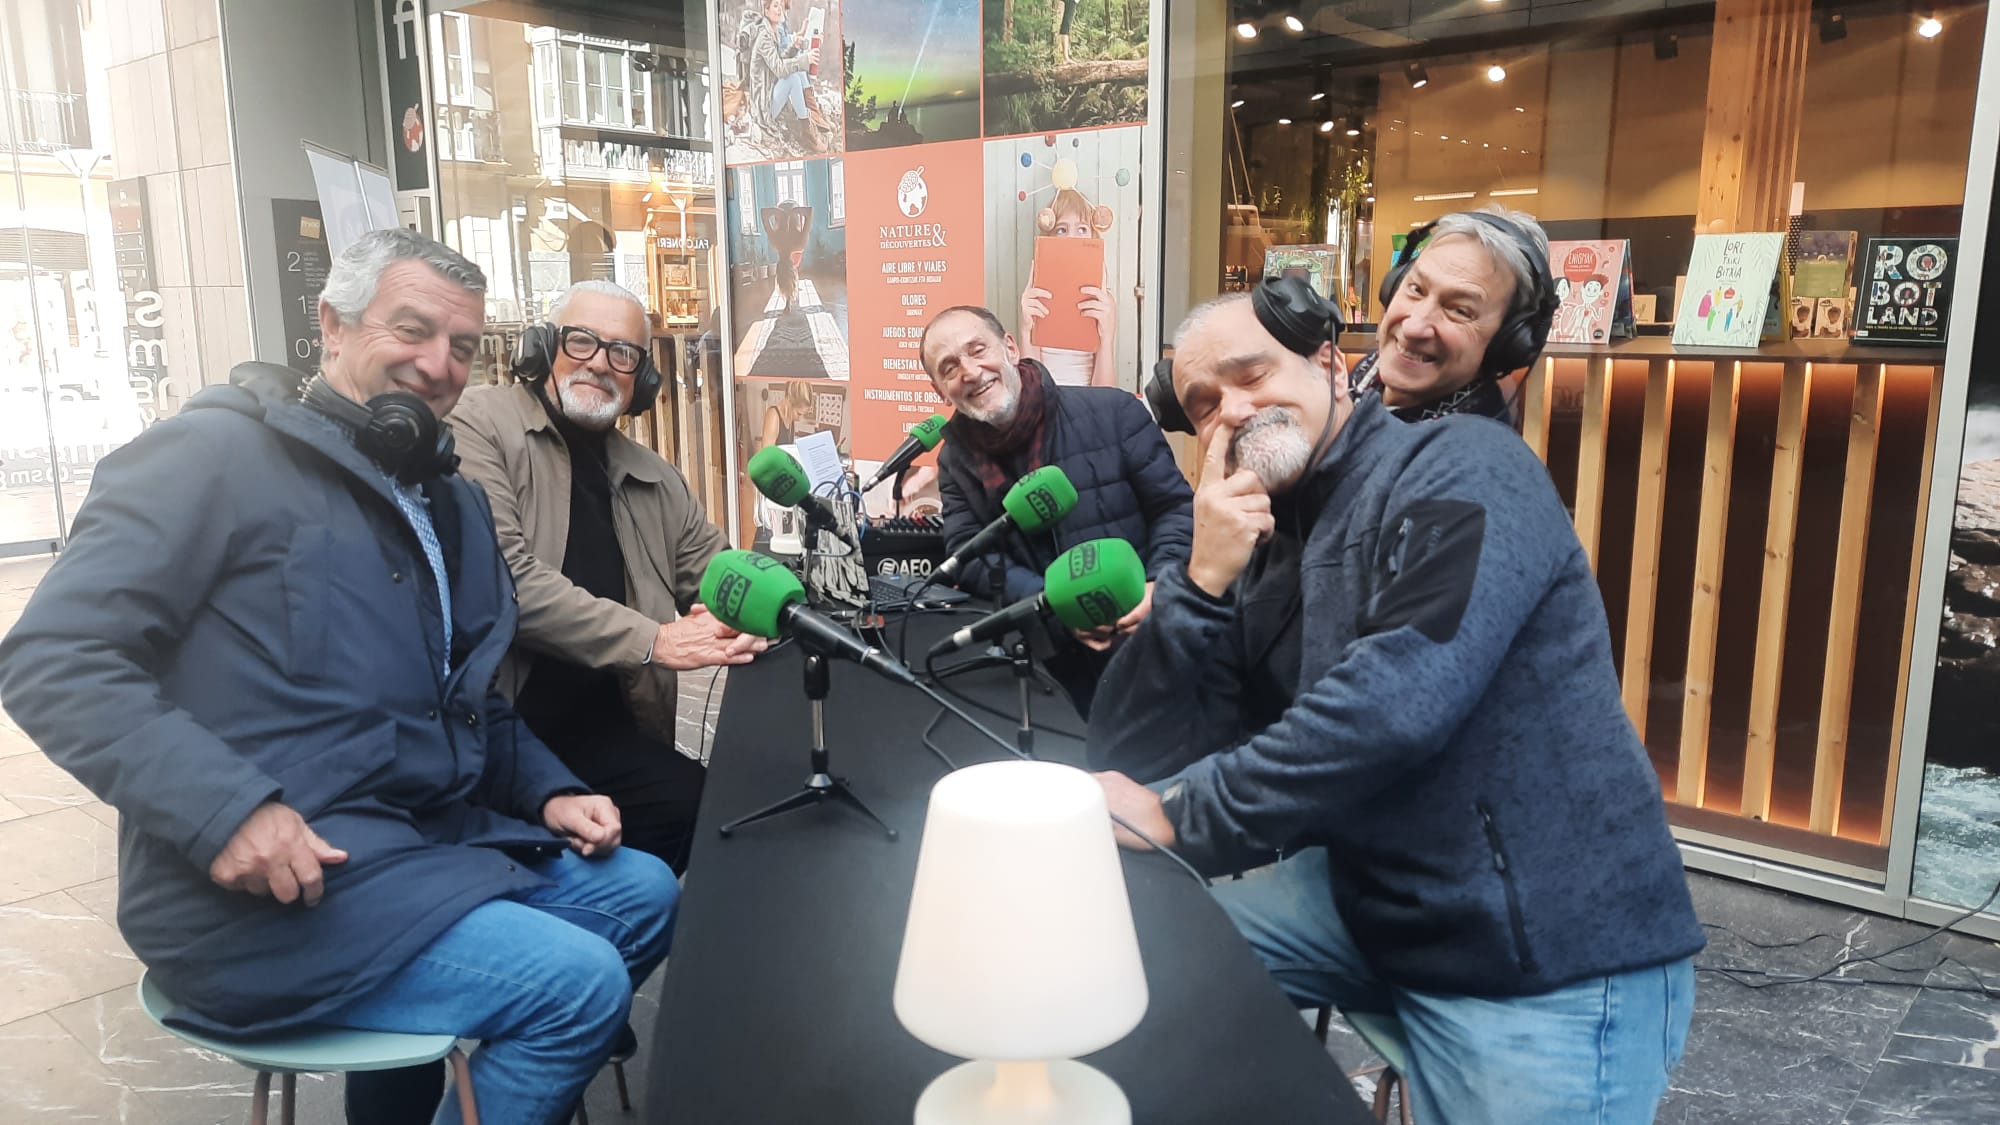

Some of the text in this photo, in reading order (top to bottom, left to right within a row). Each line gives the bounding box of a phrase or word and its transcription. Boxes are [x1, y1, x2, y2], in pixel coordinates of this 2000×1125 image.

[880, 223, 948, 247] NATURE &
[880, 239, 932, 249] DÉCOUVERTES
[1723, 239, 1746, 256] LORE
[287, 251, 302, 272] 2
[882, 260, 947, 273] AIRE LIBRE Y VIAJES
[1873, 244, 1948, 280] RO
[901, 294, 927, 306] OLORES
[1869, 280, 1943, 307] BOT
[297, 295, 307, 314] 1
[1866, 306, 1938, 326] LAND
[882, 326, 906, 338] JUEGOS
[295, 338, 311, 359] 0
[883, 358, 918, 371] BIENESTAR
[864, 388, 913, 401] INSTRUMENTOS
[914, 391, 923, 402] DE
[900, 558, 932, 577] AEQ
